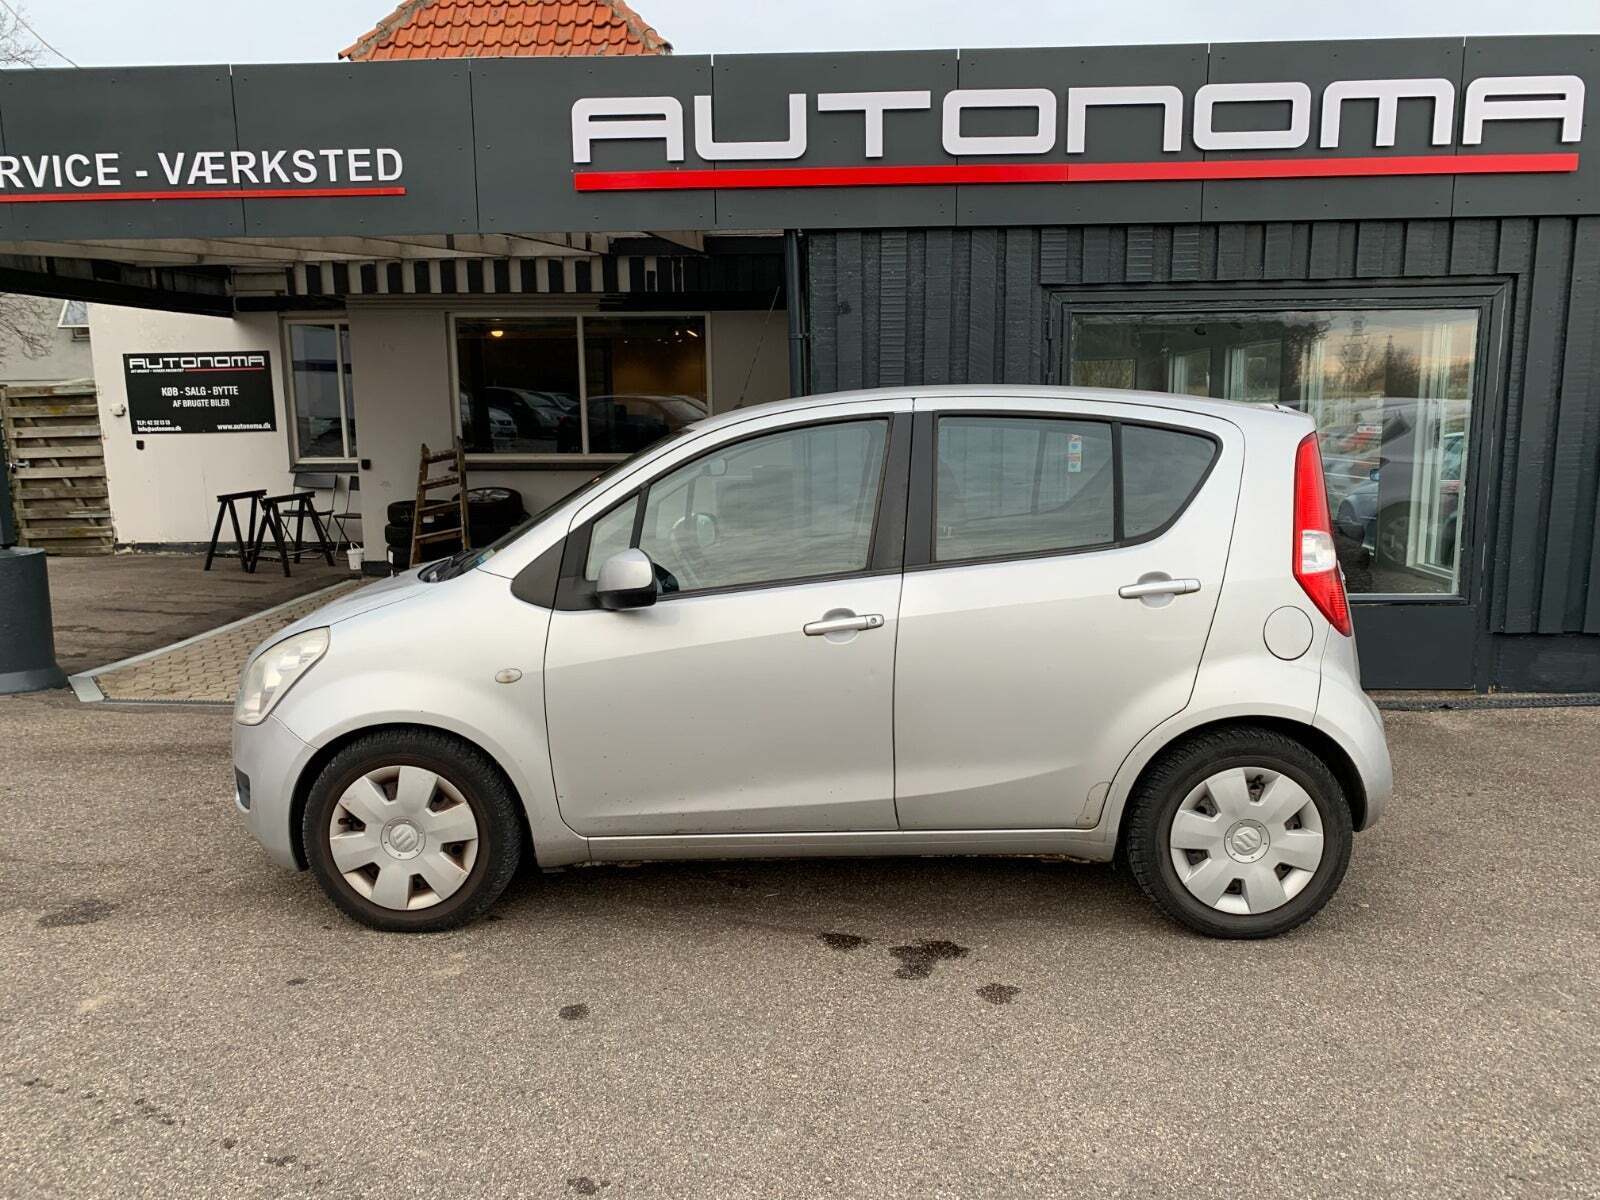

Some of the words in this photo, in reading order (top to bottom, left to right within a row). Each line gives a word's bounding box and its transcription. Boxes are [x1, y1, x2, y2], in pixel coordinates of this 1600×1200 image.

[572, 74, 1585, 163] AUTONOMA
[157, 149, 403, 185] VÆRKSTED
[129, 355, 265, 369] AUTONOMA
[161, 387, 179, 396] KØB
[185, 386, 207, 396] SALG
[213, 386, 239, 396] BYTTE
[172, 400, 182, 408] AF
[182, 399, 209, 408] BRUGTE
[210, 399, 230, 407] BILER
[217, 422, 271, 430] www.autonoma.dk
